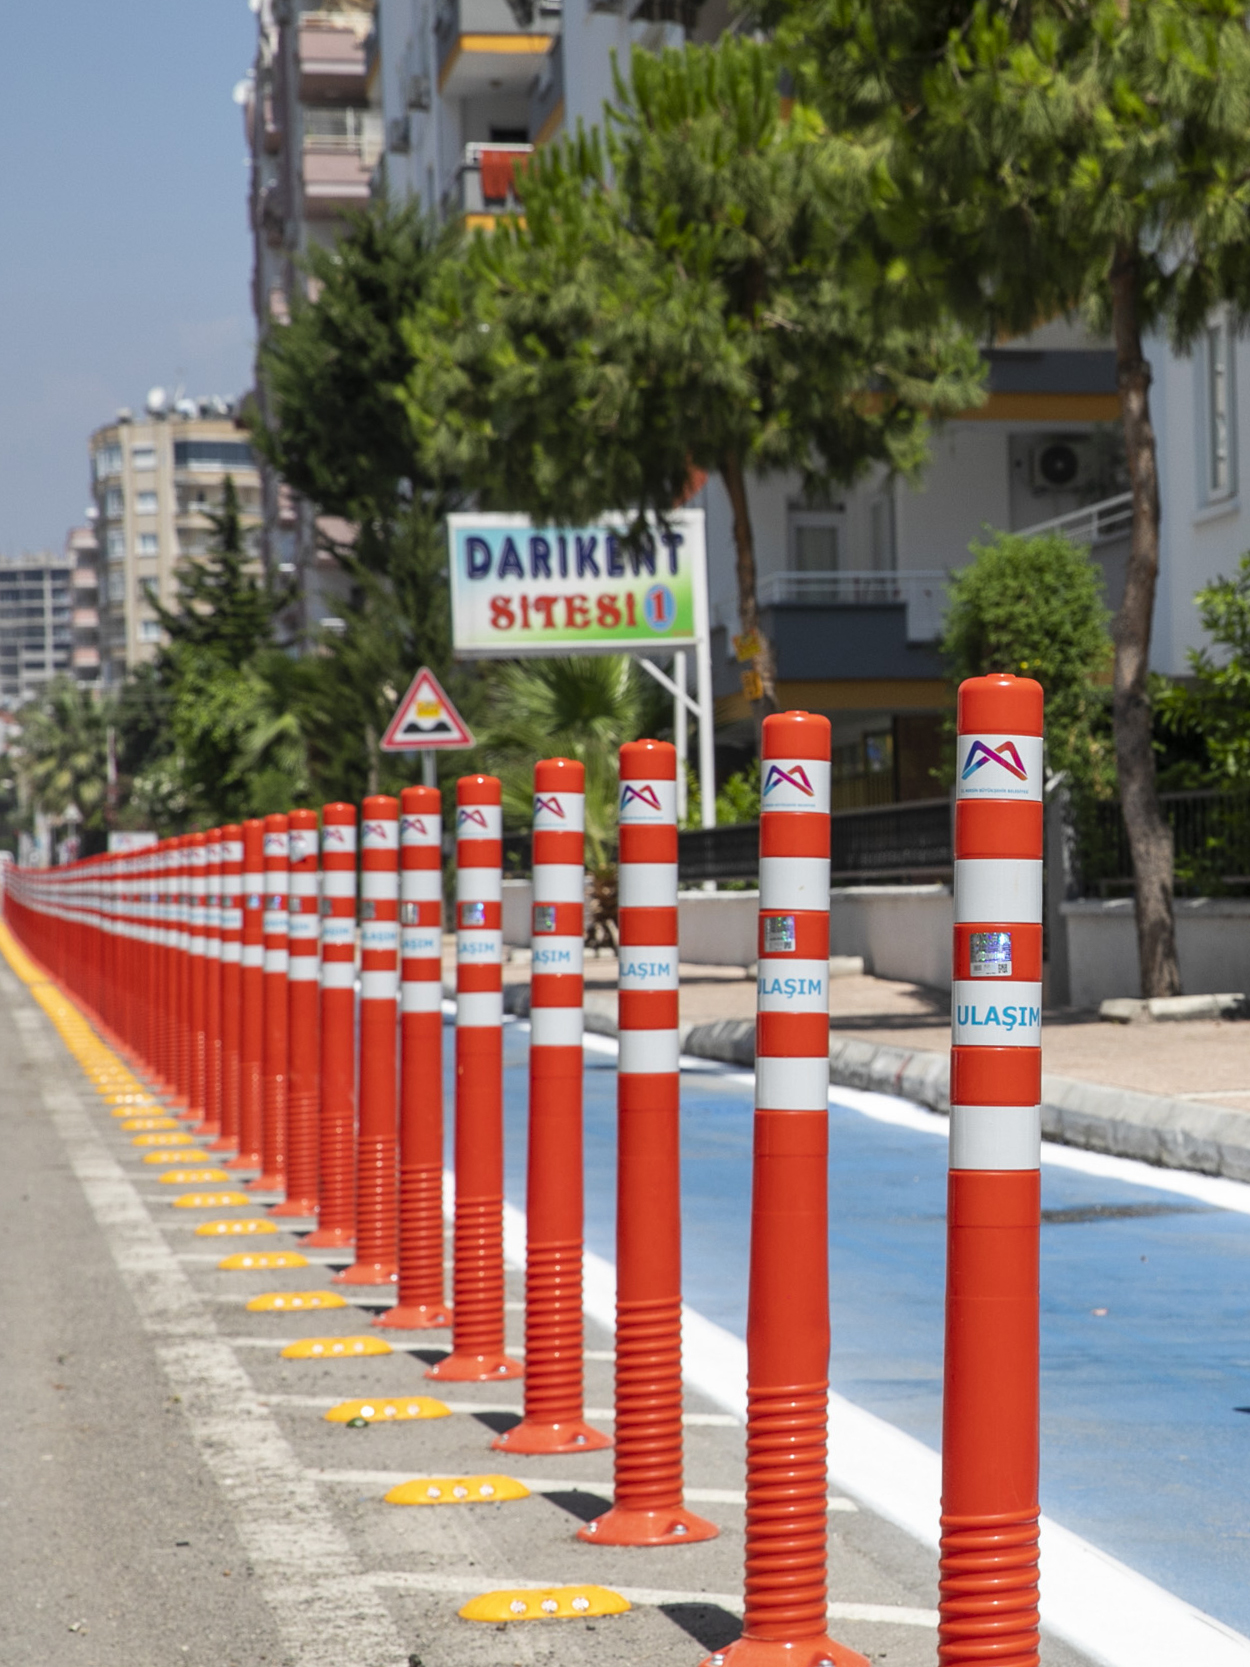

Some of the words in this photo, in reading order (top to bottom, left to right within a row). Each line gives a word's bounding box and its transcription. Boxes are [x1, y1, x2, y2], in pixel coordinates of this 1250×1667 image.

[465, 532, 684, 580] DARIKENT
[652, 589, 667, 623] 1
[618, 962, 671, 980] LAŞIM
[758, 977, 822, 999] LAŞIM
[957, 1005, 1040, 1031] ULAŞIM
